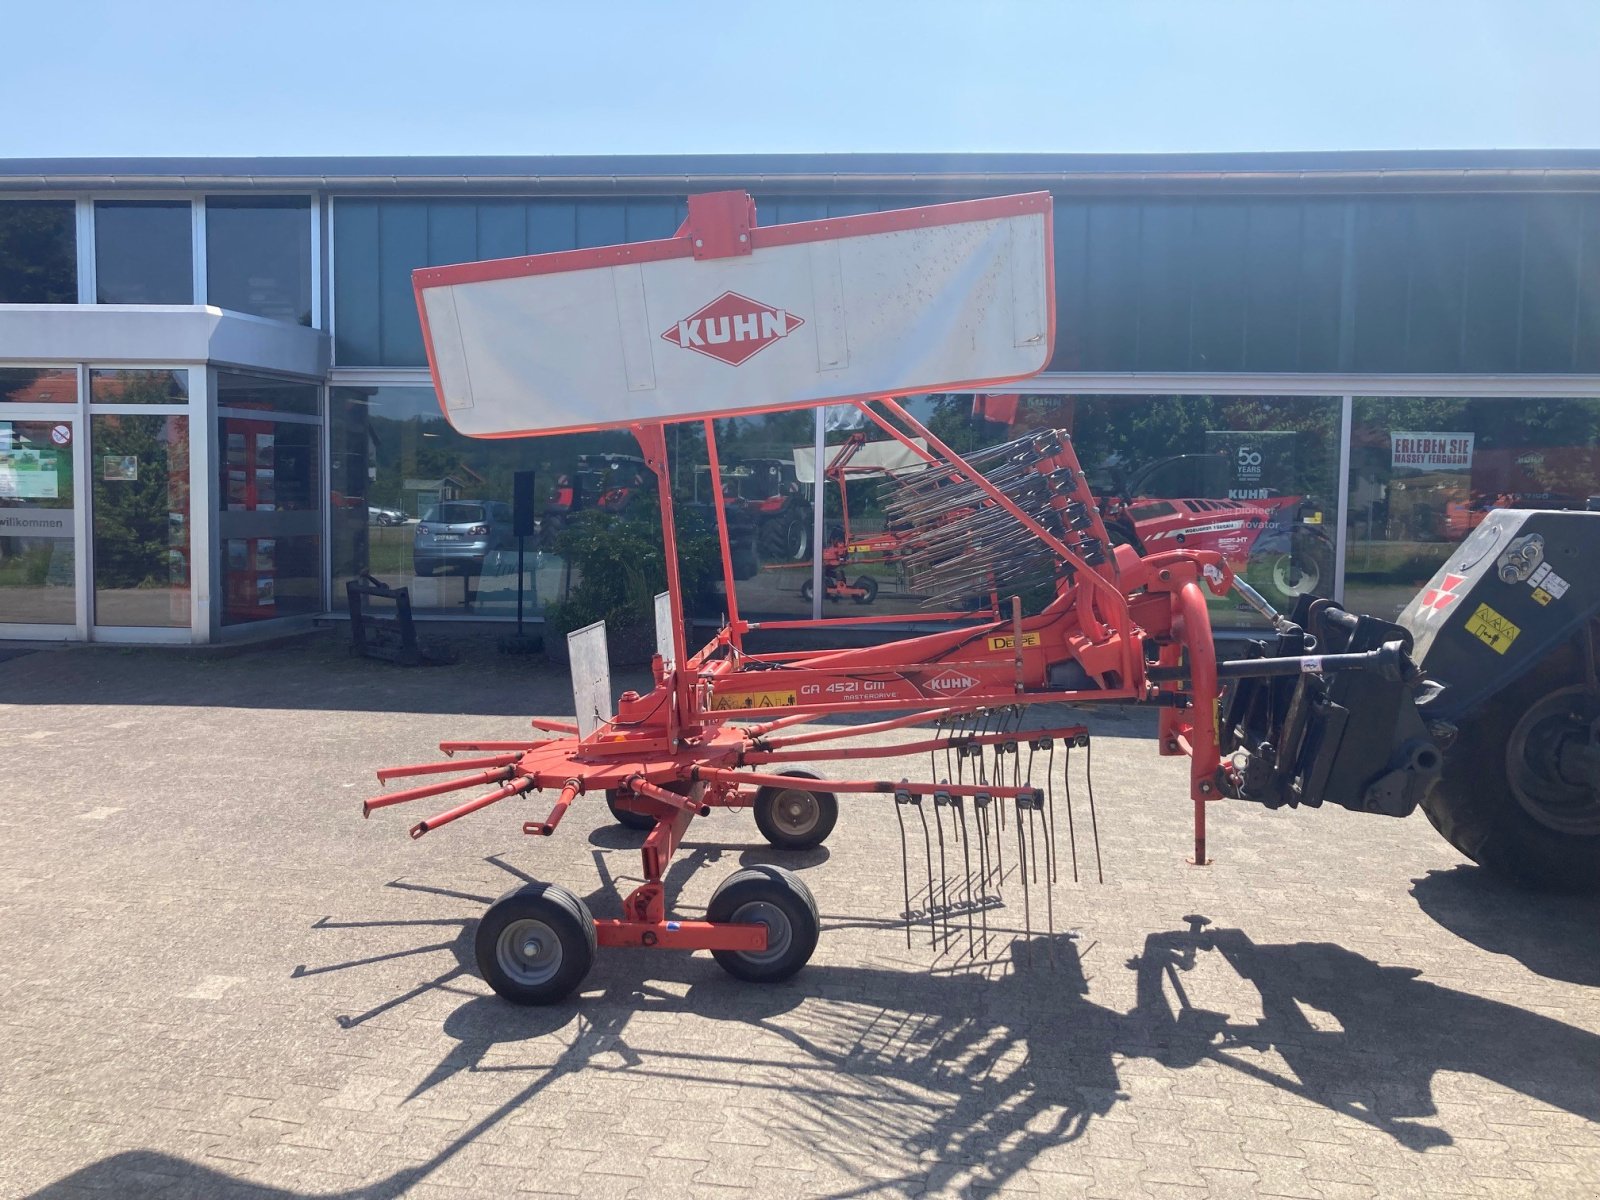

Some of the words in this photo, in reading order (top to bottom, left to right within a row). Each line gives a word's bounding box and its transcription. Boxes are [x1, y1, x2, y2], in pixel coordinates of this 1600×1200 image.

[677, 309, 788, 348] KUHN
[1395, 439, 1447, 454] ERLEBEN
[1449, 439, 1469, 454] SIE
[1238, 447, 1262, 465] 50
[1394, 453, 1425, 464] MASSEY
[1428, 454, 1469, 465] FERGUSON
[1237, 465, 1261, 473] YEARS
[1228, 489, 1269, 499] KUHN
[0, 517, 63, 528] willkommen
[1231, 520, 1281, 529] novator
[993, 637, 1036, 649] DEPE
[801, 685, 820, 695] GA
[826, 682, 859, 692] 4521
[863, 681, 885, 691] GM
[931, 677, 972, 690] KUHN
[843, 692, 897, 701] MASTERDRIVE
